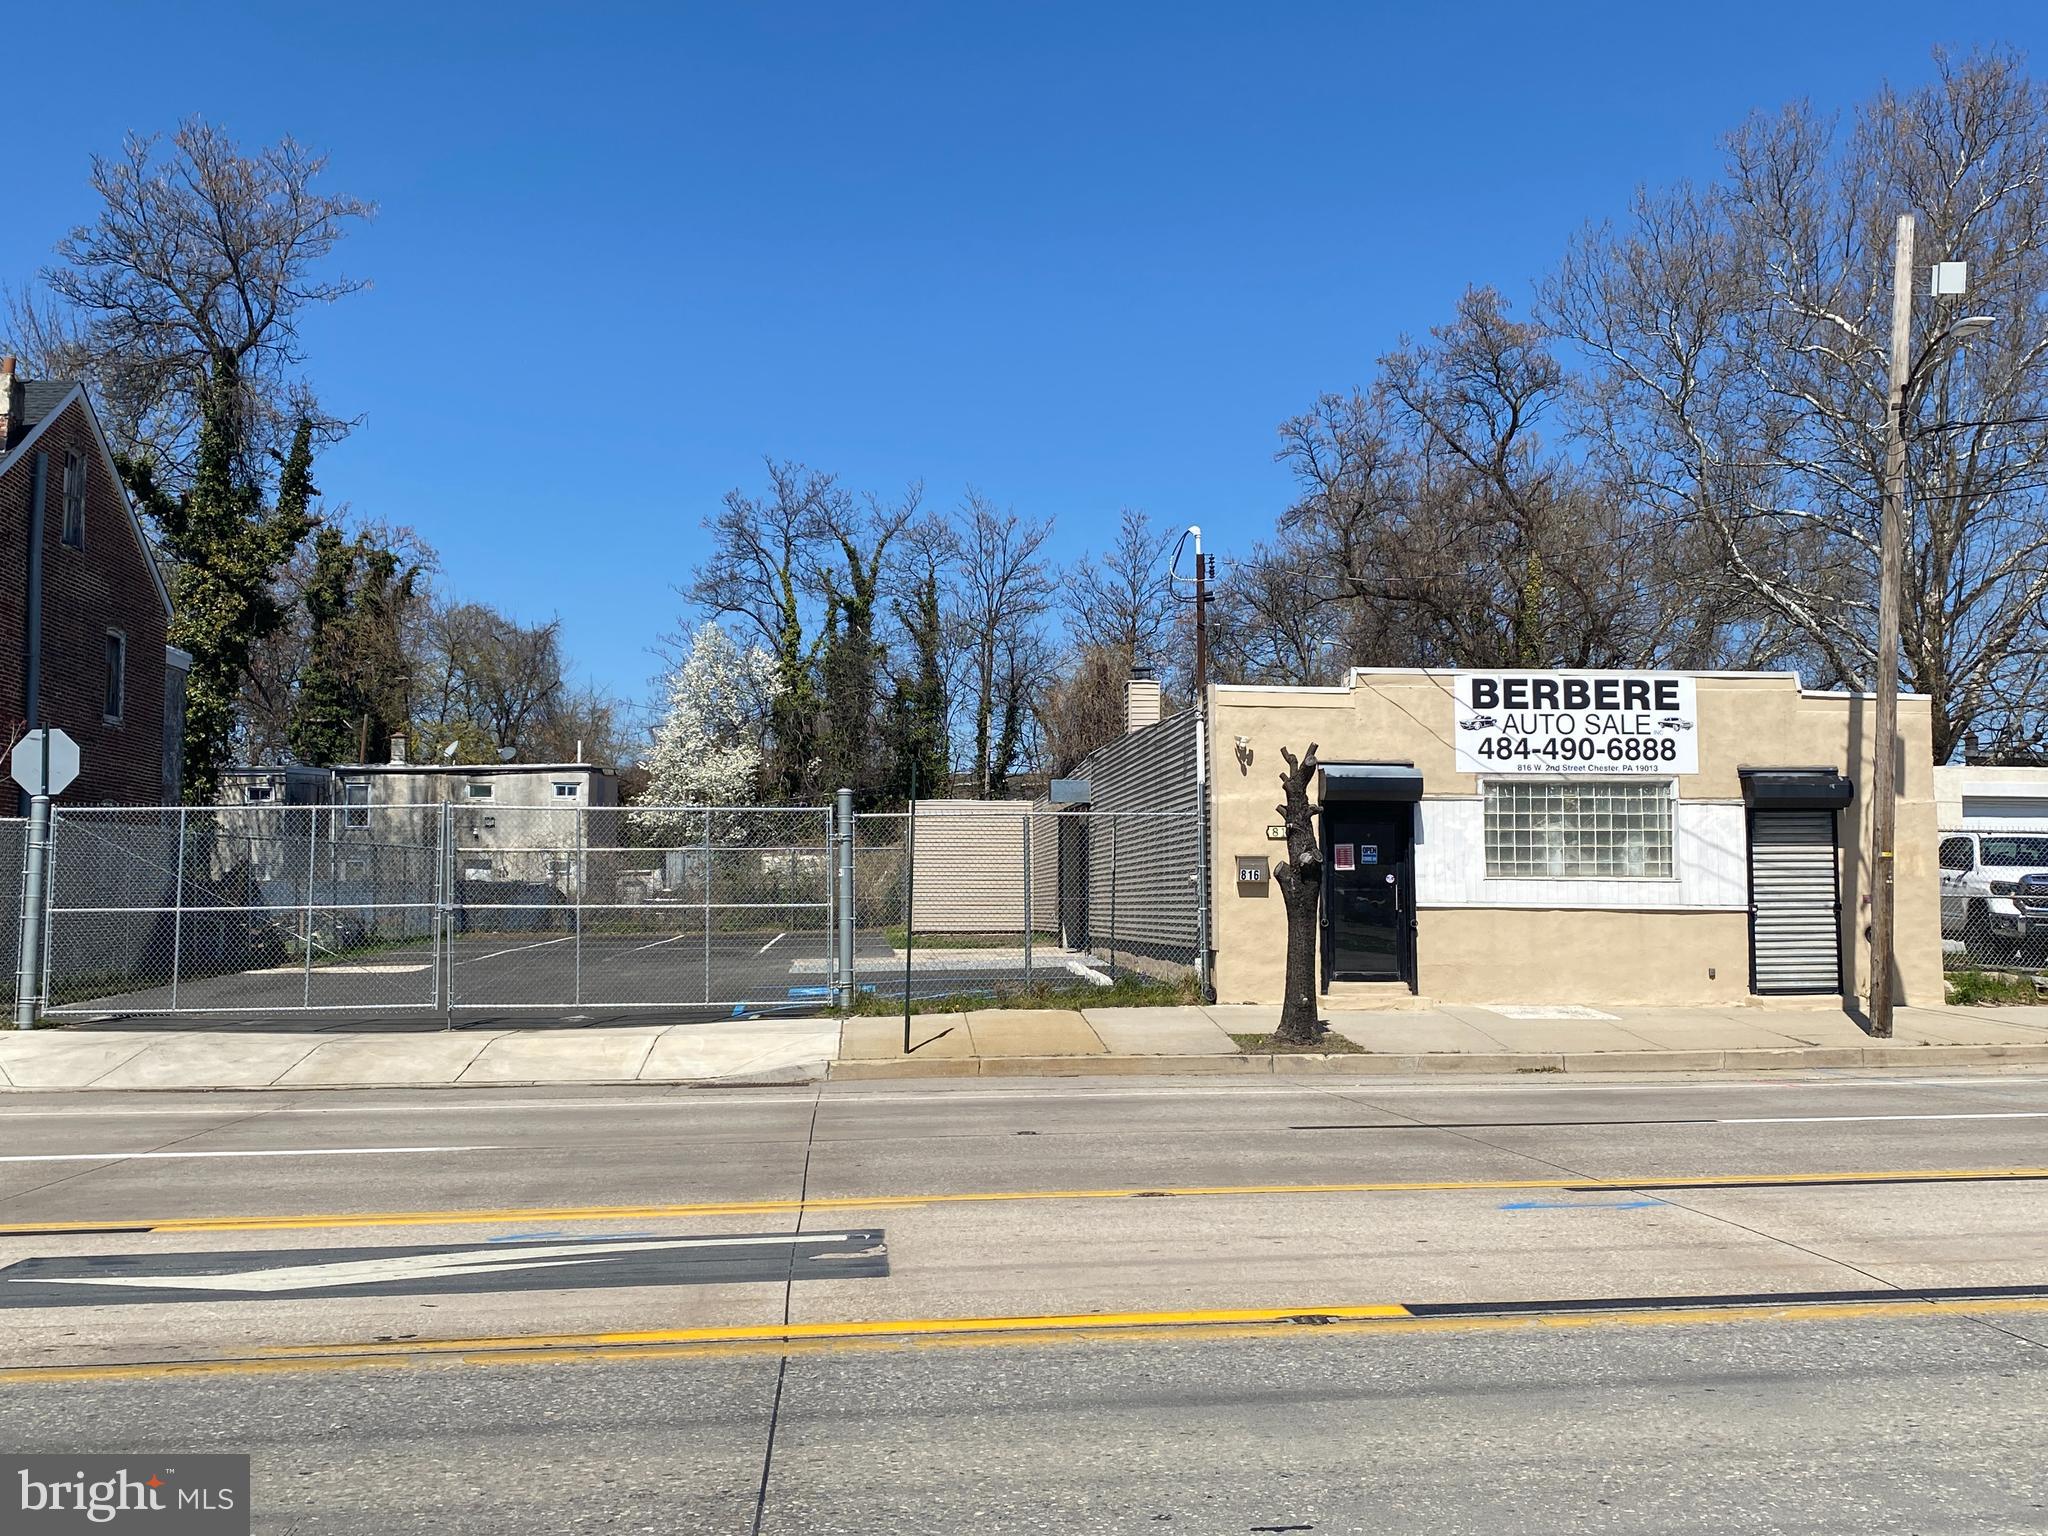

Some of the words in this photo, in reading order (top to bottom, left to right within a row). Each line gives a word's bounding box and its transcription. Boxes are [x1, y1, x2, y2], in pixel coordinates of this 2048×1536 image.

[1472, 678, 1680, 710] BERBERE
[1502, 713, 1575, 734] AUTO
[1585, 713, 1651, 735] SALE
[1478, 736, 1676, 761] 484-490-6888
[1517, 764, 1532, 772] 816
[1545, 764, 1560, 772] 2nd
[1562, 764, 1586, 772] Street
[1622, 764, 1633, 772] PA
[1635, 764, 1659, 772] 19013
[1240, 870, 1259, 881] 816
